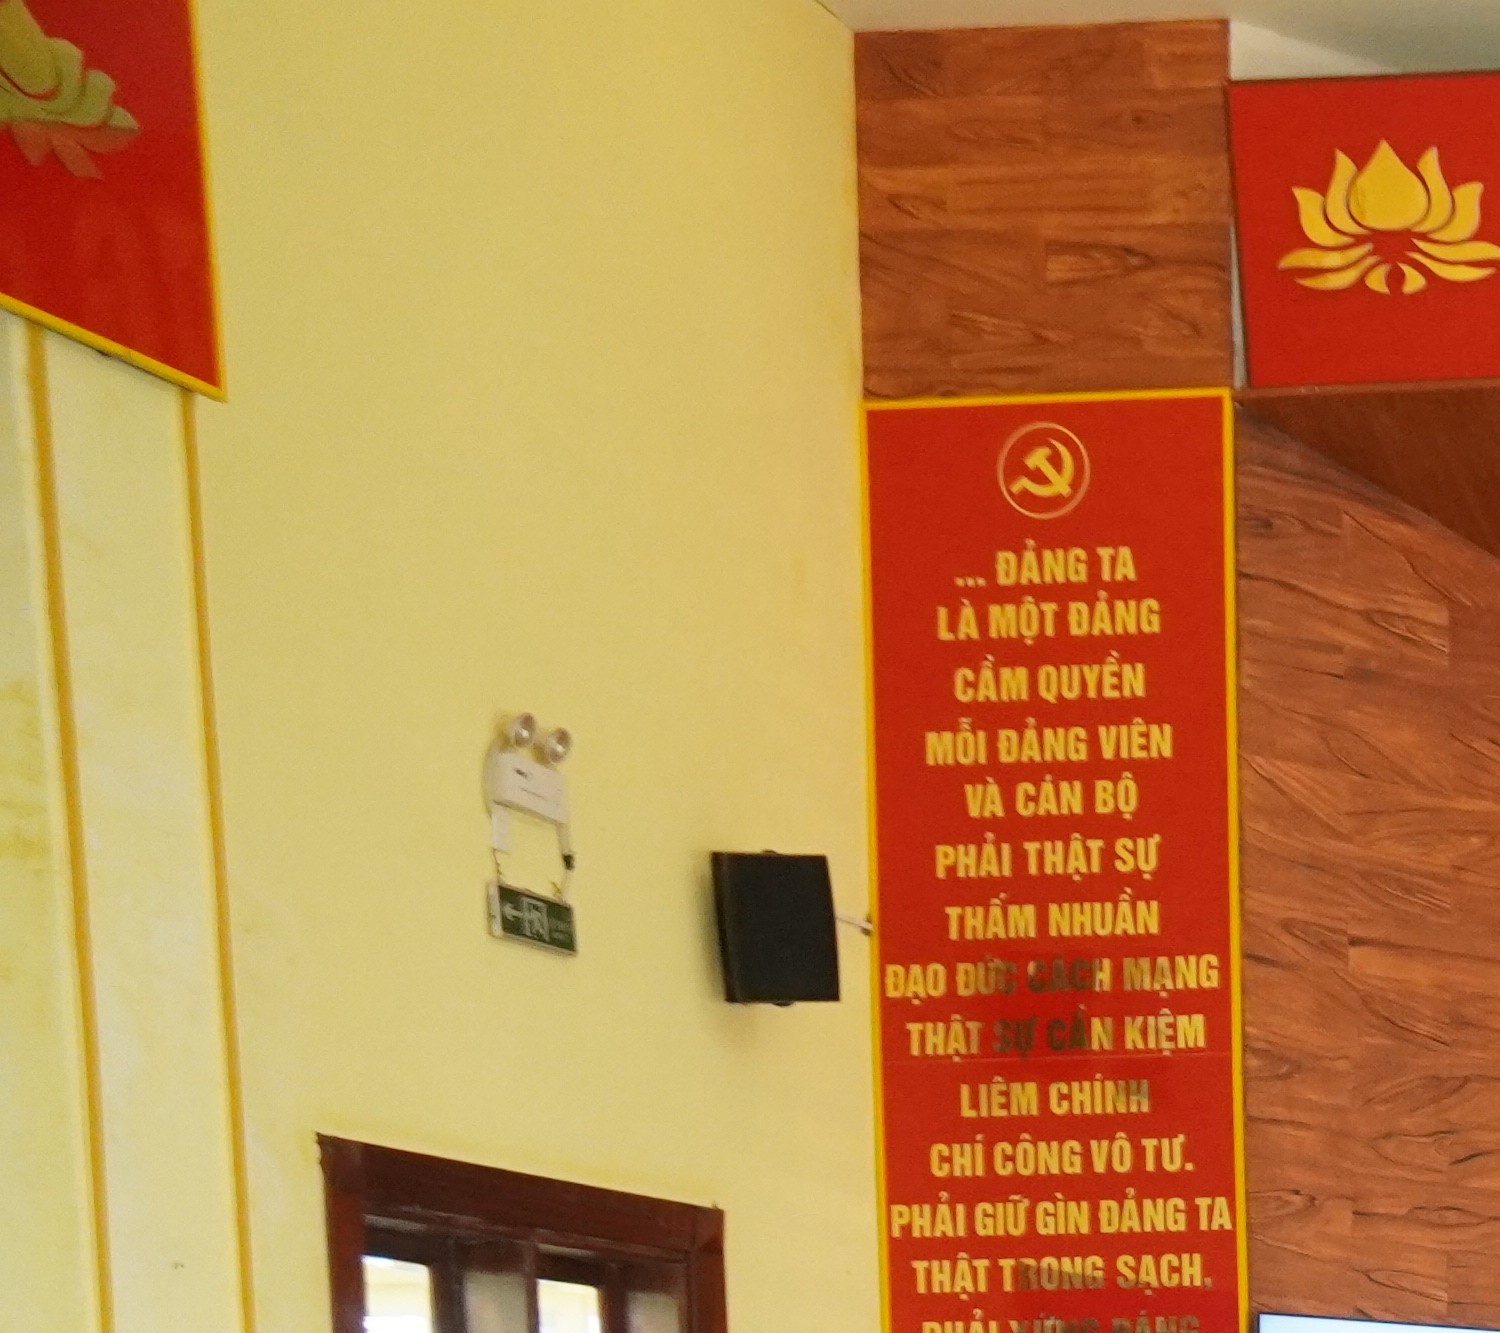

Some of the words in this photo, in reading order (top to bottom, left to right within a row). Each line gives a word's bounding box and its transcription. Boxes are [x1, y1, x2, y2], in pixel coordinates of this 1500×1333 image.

[996, 538, 1088, 586] ĐẢNG
[1096, 546, 1137, 583] TA
[937, 598, 980, 641] LÀ
[988, 596, 1058, 646] MỘT
[1068, 590, 1161, 636] ĐẢNG
[954, 654, 1029, 703] CẦM
[1038, 649, 1146, 704] QUYỀN
[925, 717, 988, 767] MỖI
[998, 716, 1088, 763] ĐẢNG
[1098, 717, 1174, 760] VIÊN
[965, 777, 1005, 819] VÀ
[1016, 774, 1083, 817] CÁN
[1095, 771, 1138, 820] BỘ
[935, 831, 1013, 880] PHẢI
[1023, 832, 1105, 882] THẬT
[1114, 833, 1162, 881] SỰ
[945, 892, 1036, 941] THẤM
[1048, 887, 1159, 936] NHUẦN
[885, 962, 947, 1005] ĐẠO
[956, 953, 1017, 997] ĐỨC
[1027, 954, 1112, 993] CÁCH
[1122, 954, 1220, 999] MẠNG
[906, 1014, 983, 1062] THẬT
[993, 1016, 1039, 1061] SỰ
[1047, 1003, 1114, 1052] CẦN
[1124, 1008, 1206, 1056] KIỆM
[960, 1075, 1038, 1118] LIÊM
[1049, 1072, 1150, 1116] CHÍNH
[930, 1134, 985, 1178] CHÍ
[993, 1133, 1083, 1176] CÔNG
[1090, 1132, 1132, 1174] VÔ
[1141, 1134, 1194, 1172] TƯ.
[890, 1191, 966, 1239] PHẢI
[974, 1195, 1030, 1237] GIỮ
[1036, 1192, 1090, 1235] GÌN
[1099, 1188, 1187, 1233] ĐẢNG
[1195, 1196, 1233, 1232] TA
[911, 1252, 990, 1300] THẬT
[998, 1255, 1105, 1293] TRONG
[1116, 1252, 1213, 1296] SẠCH,
